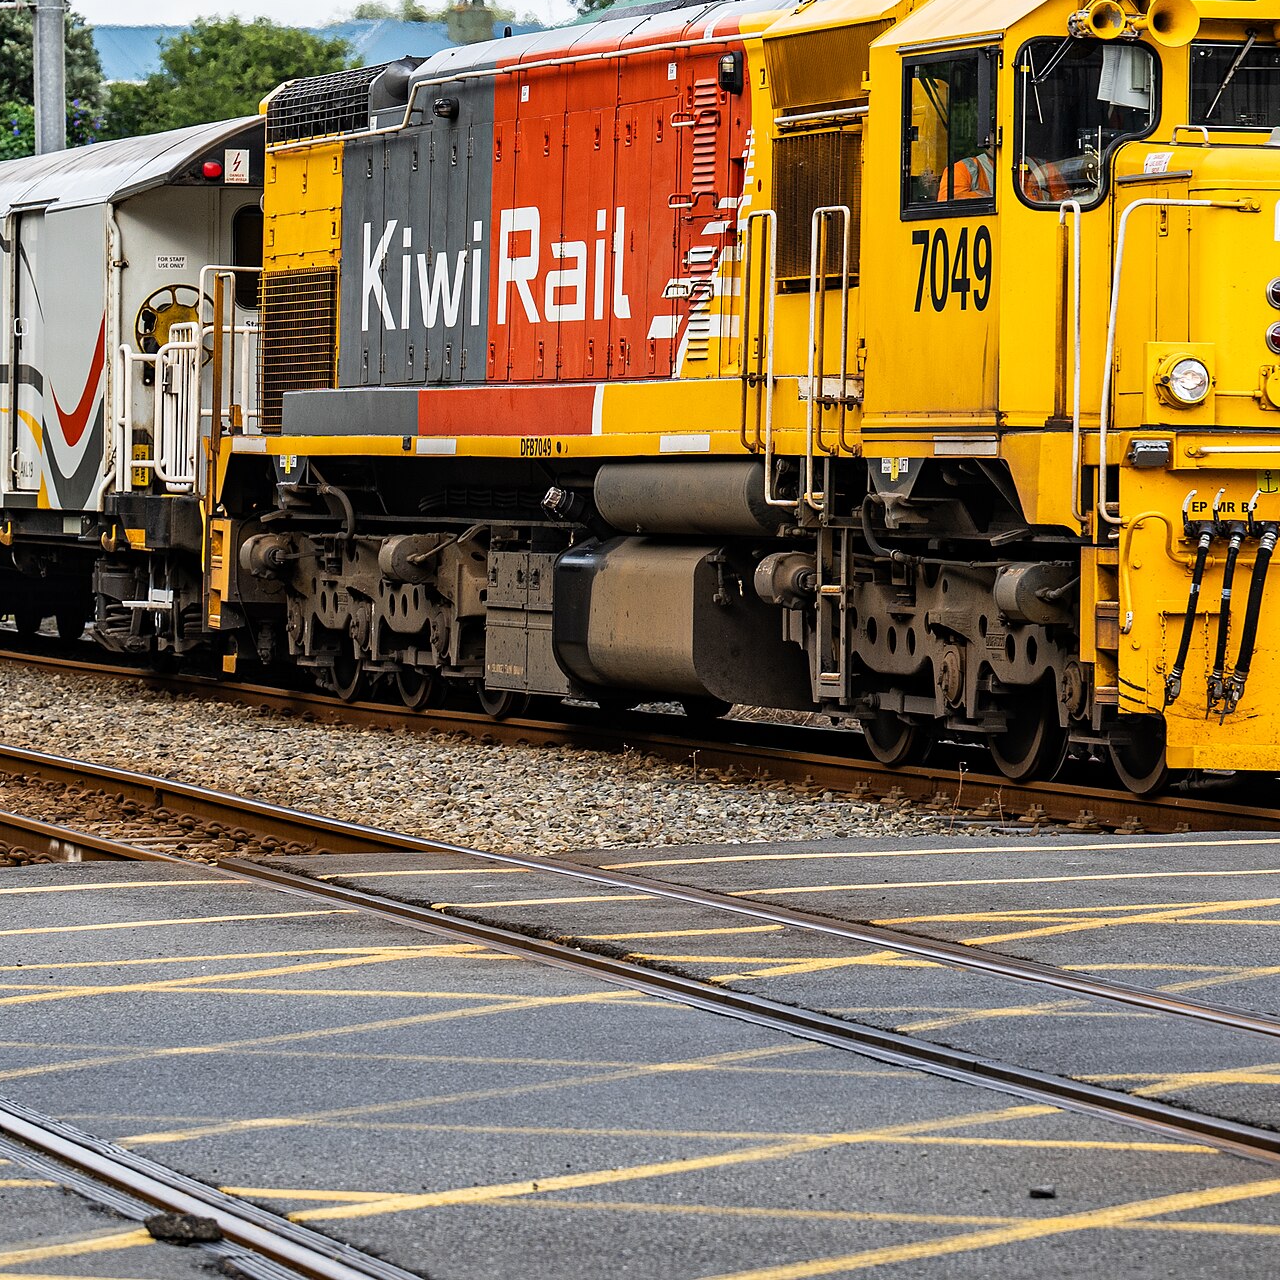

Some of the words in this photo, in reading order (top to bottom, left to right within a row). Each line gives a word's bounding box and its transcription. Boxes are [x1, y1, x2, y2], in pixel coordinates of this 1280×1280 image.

[361, 206, 632, 332] KiwiRail
[912, 225, 992, 312] 7049
[520, 437, 552, 457] DFB7049
[1192, 501, 1208, 513] EP
